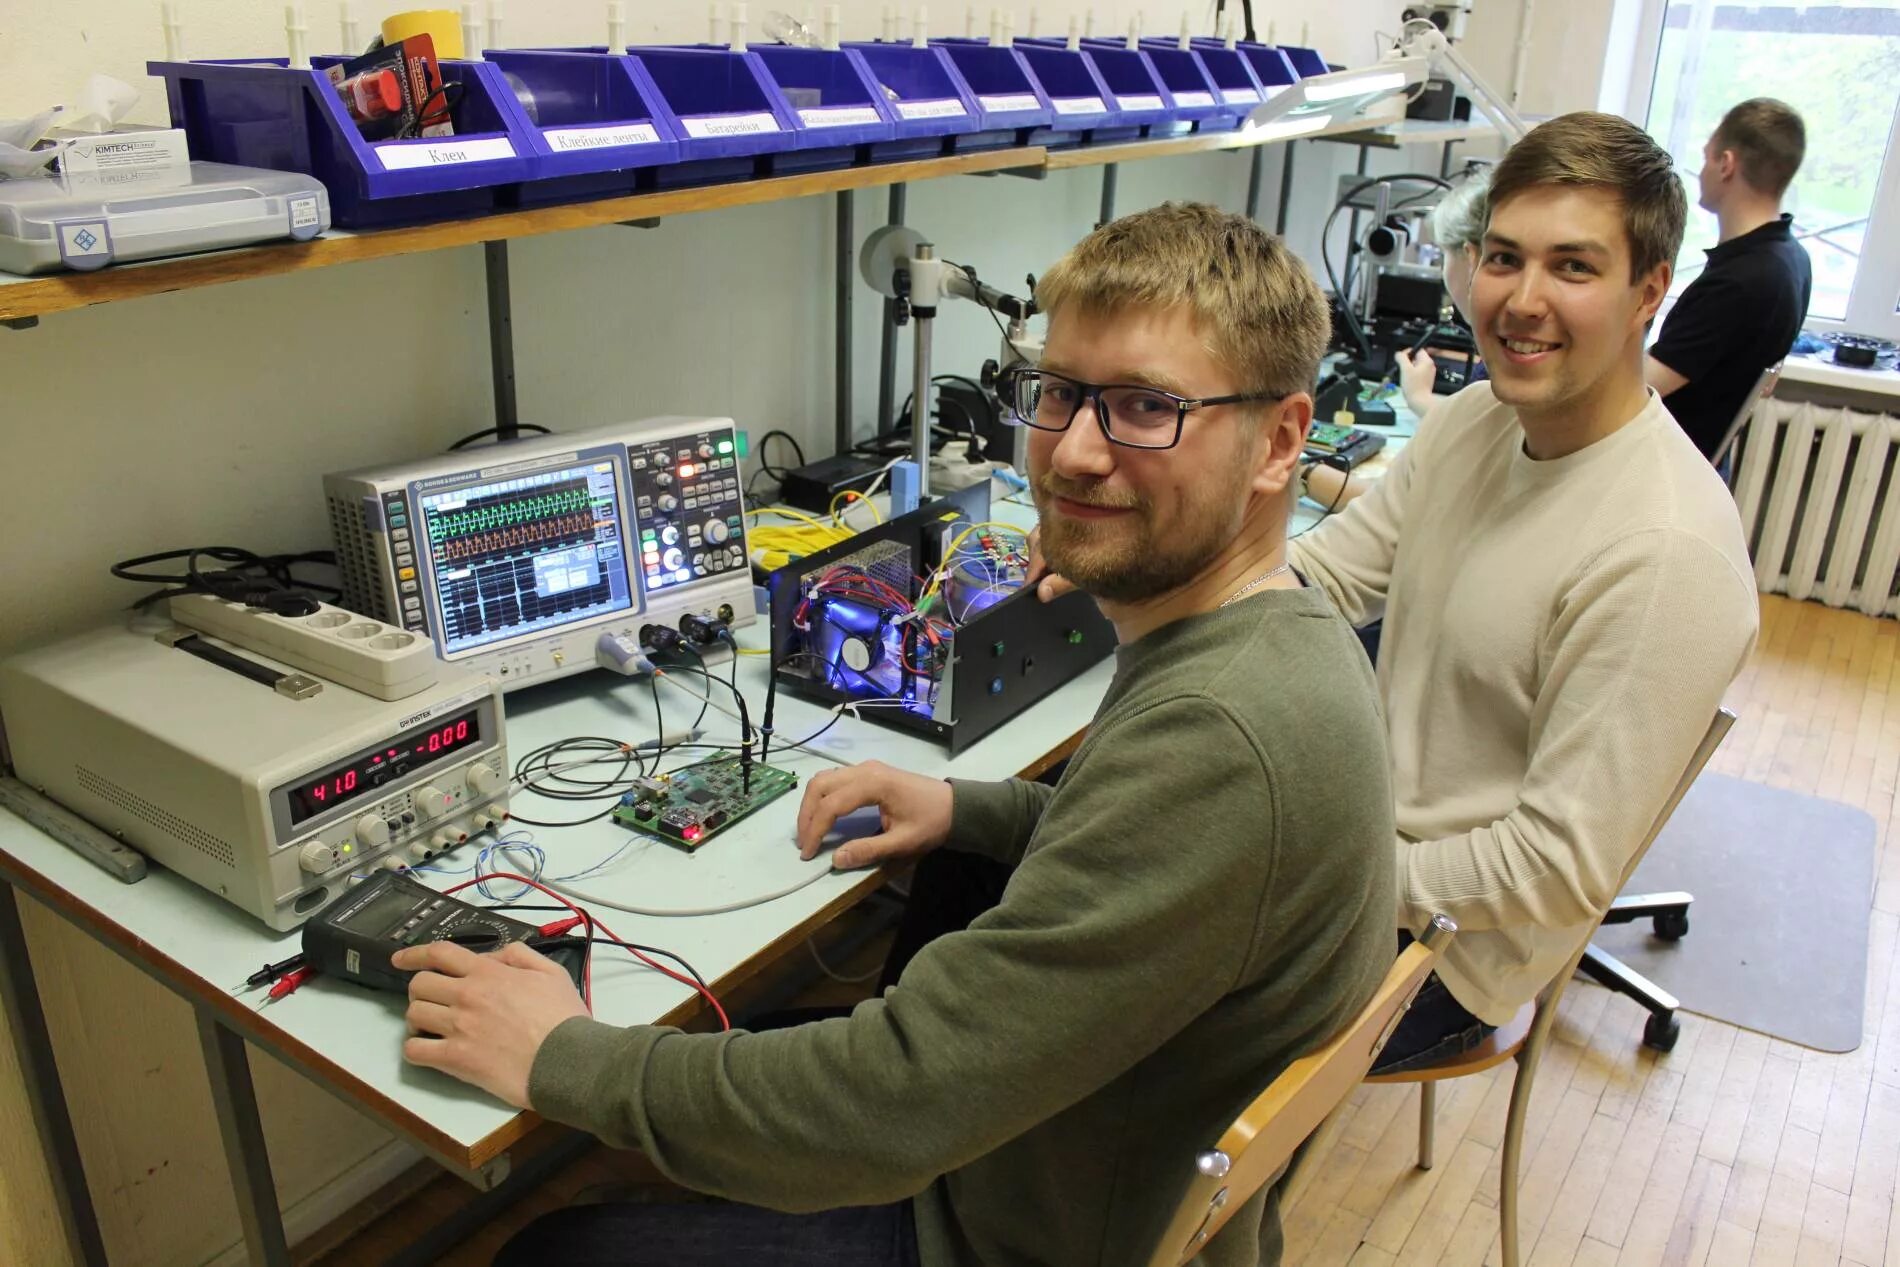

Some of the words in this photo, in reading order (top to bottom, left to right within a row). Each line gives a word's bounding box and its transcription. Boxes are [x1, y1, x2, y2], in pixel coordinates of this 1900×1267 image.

[705, 121, 760, 135] Батарейки
[558, 133, 611, 149] Клейкие
[612, 133, 648, 146] ленты
[95, 144, 134, 153] KIMTECH
[428, 149, 467, 164] Клеи
